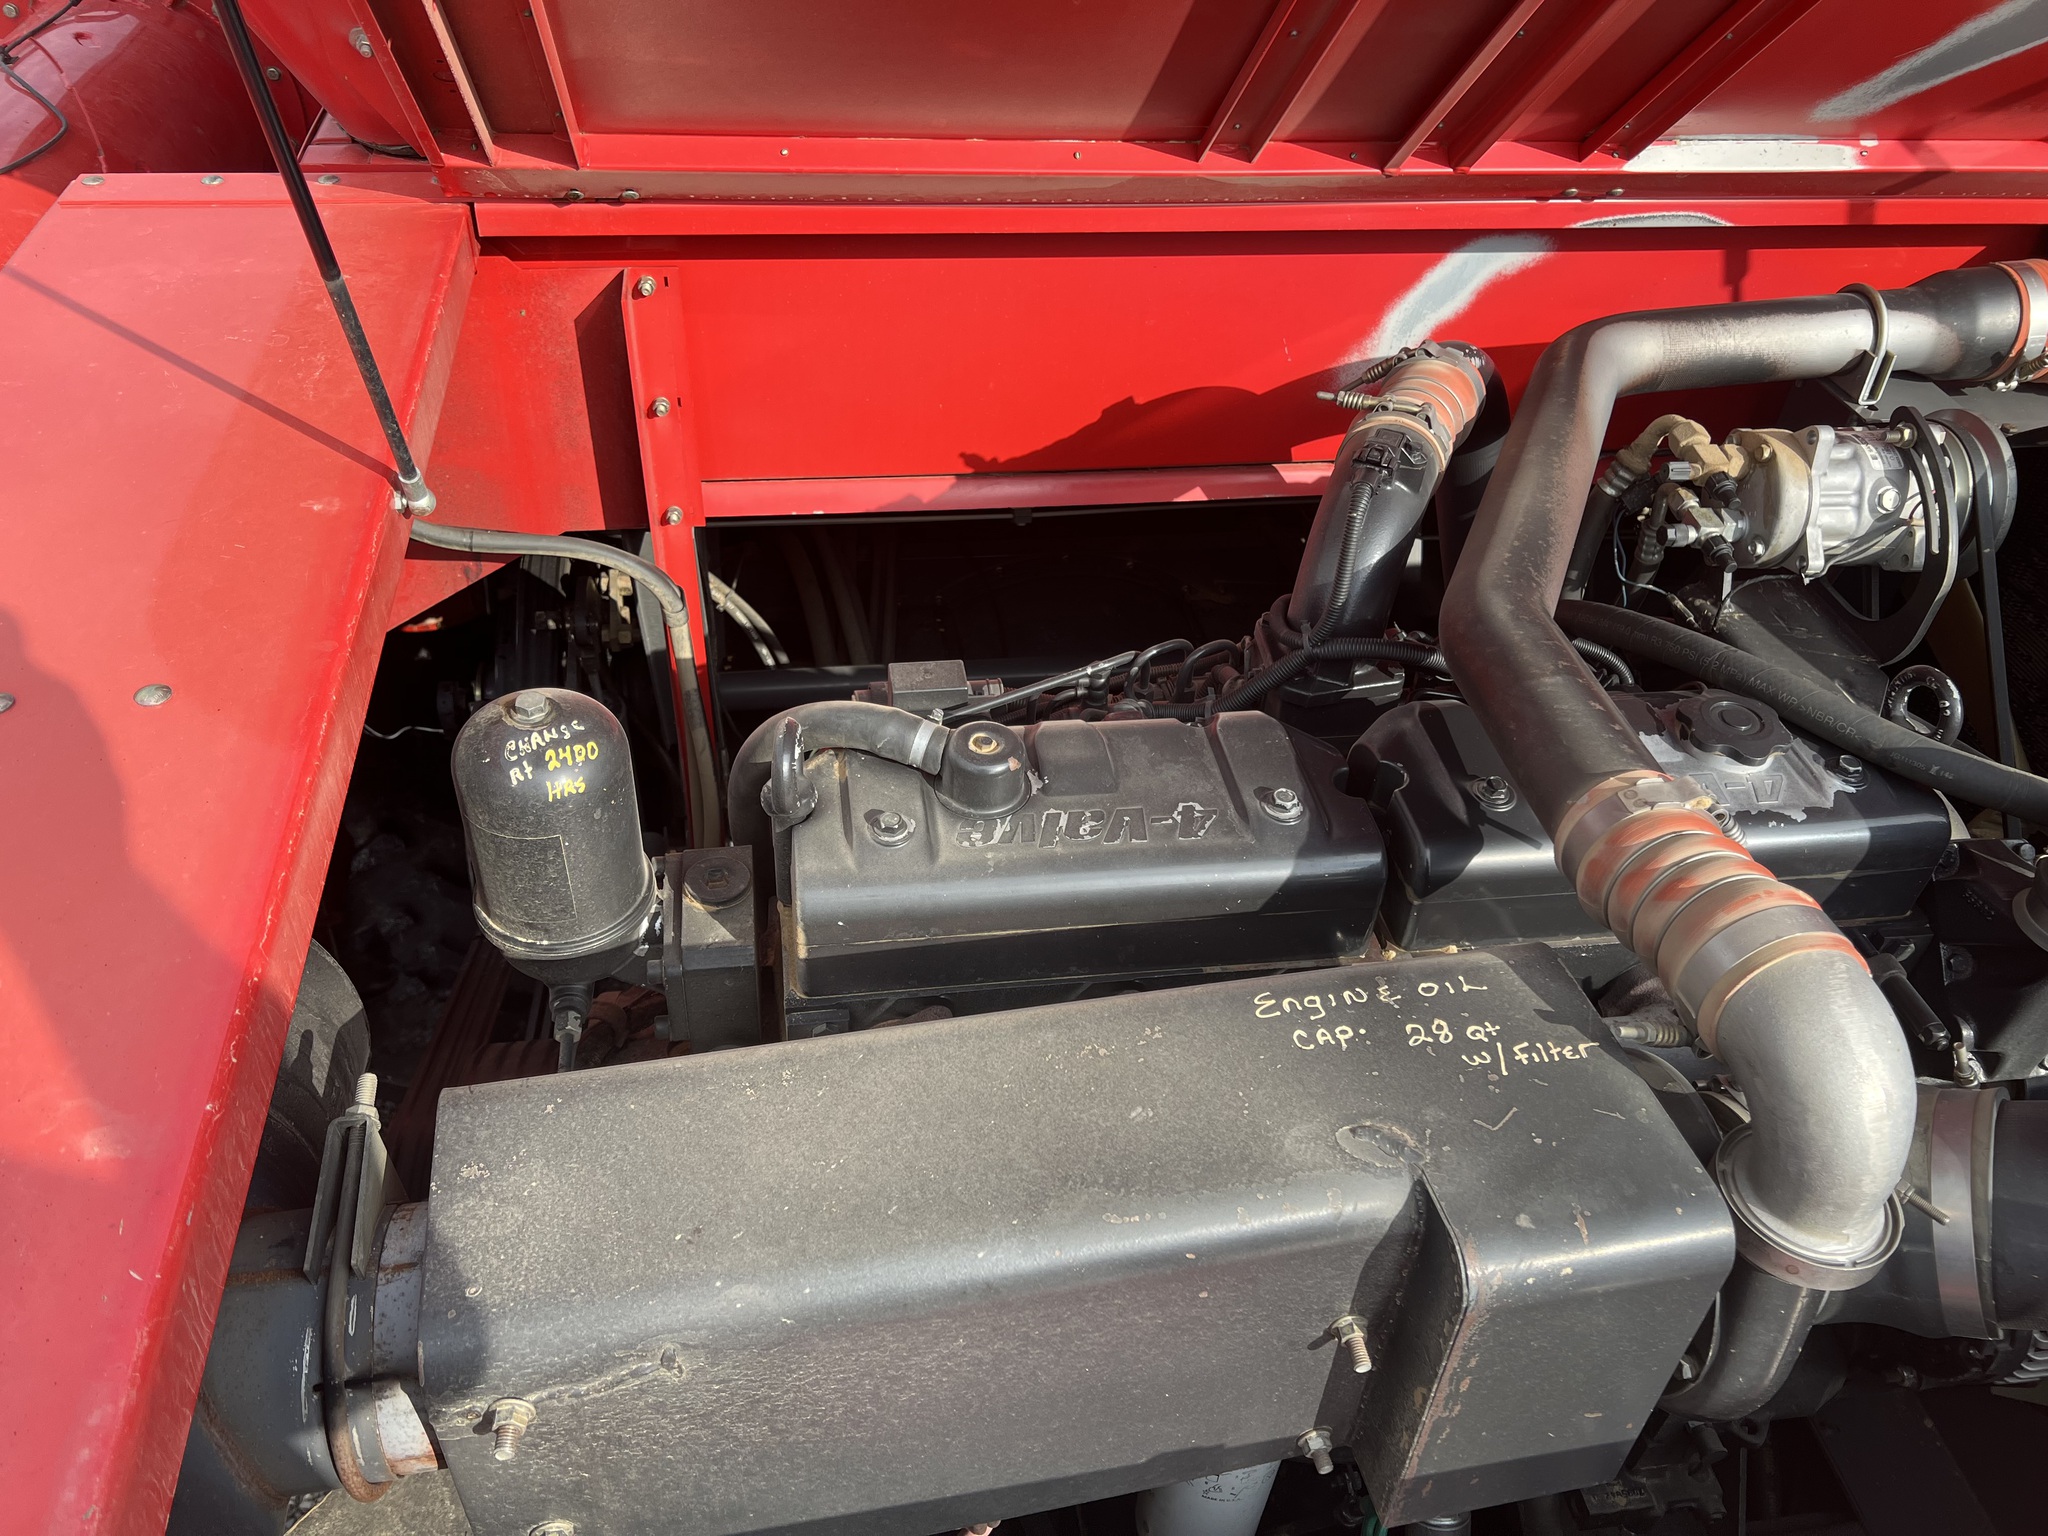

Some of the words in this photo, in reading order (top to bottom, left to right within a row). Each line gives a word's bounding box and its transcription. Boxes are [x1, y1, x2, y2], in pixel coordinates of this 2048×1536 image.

[1650, 635, 1663, 647] R3
[1664, 640, 1681, 655] 750
[1681, 647, 1699, 663] PSI
[1719, 663, 1747, 682] MPa)
[1750, 677, 1776, 698] MAX
[1777, 690, 1799, 706] WP
[544, 741, 599, 772] 2400
[545, 776, 587, 803] HRS
[1405, 1018, 1453, 1047] 28
